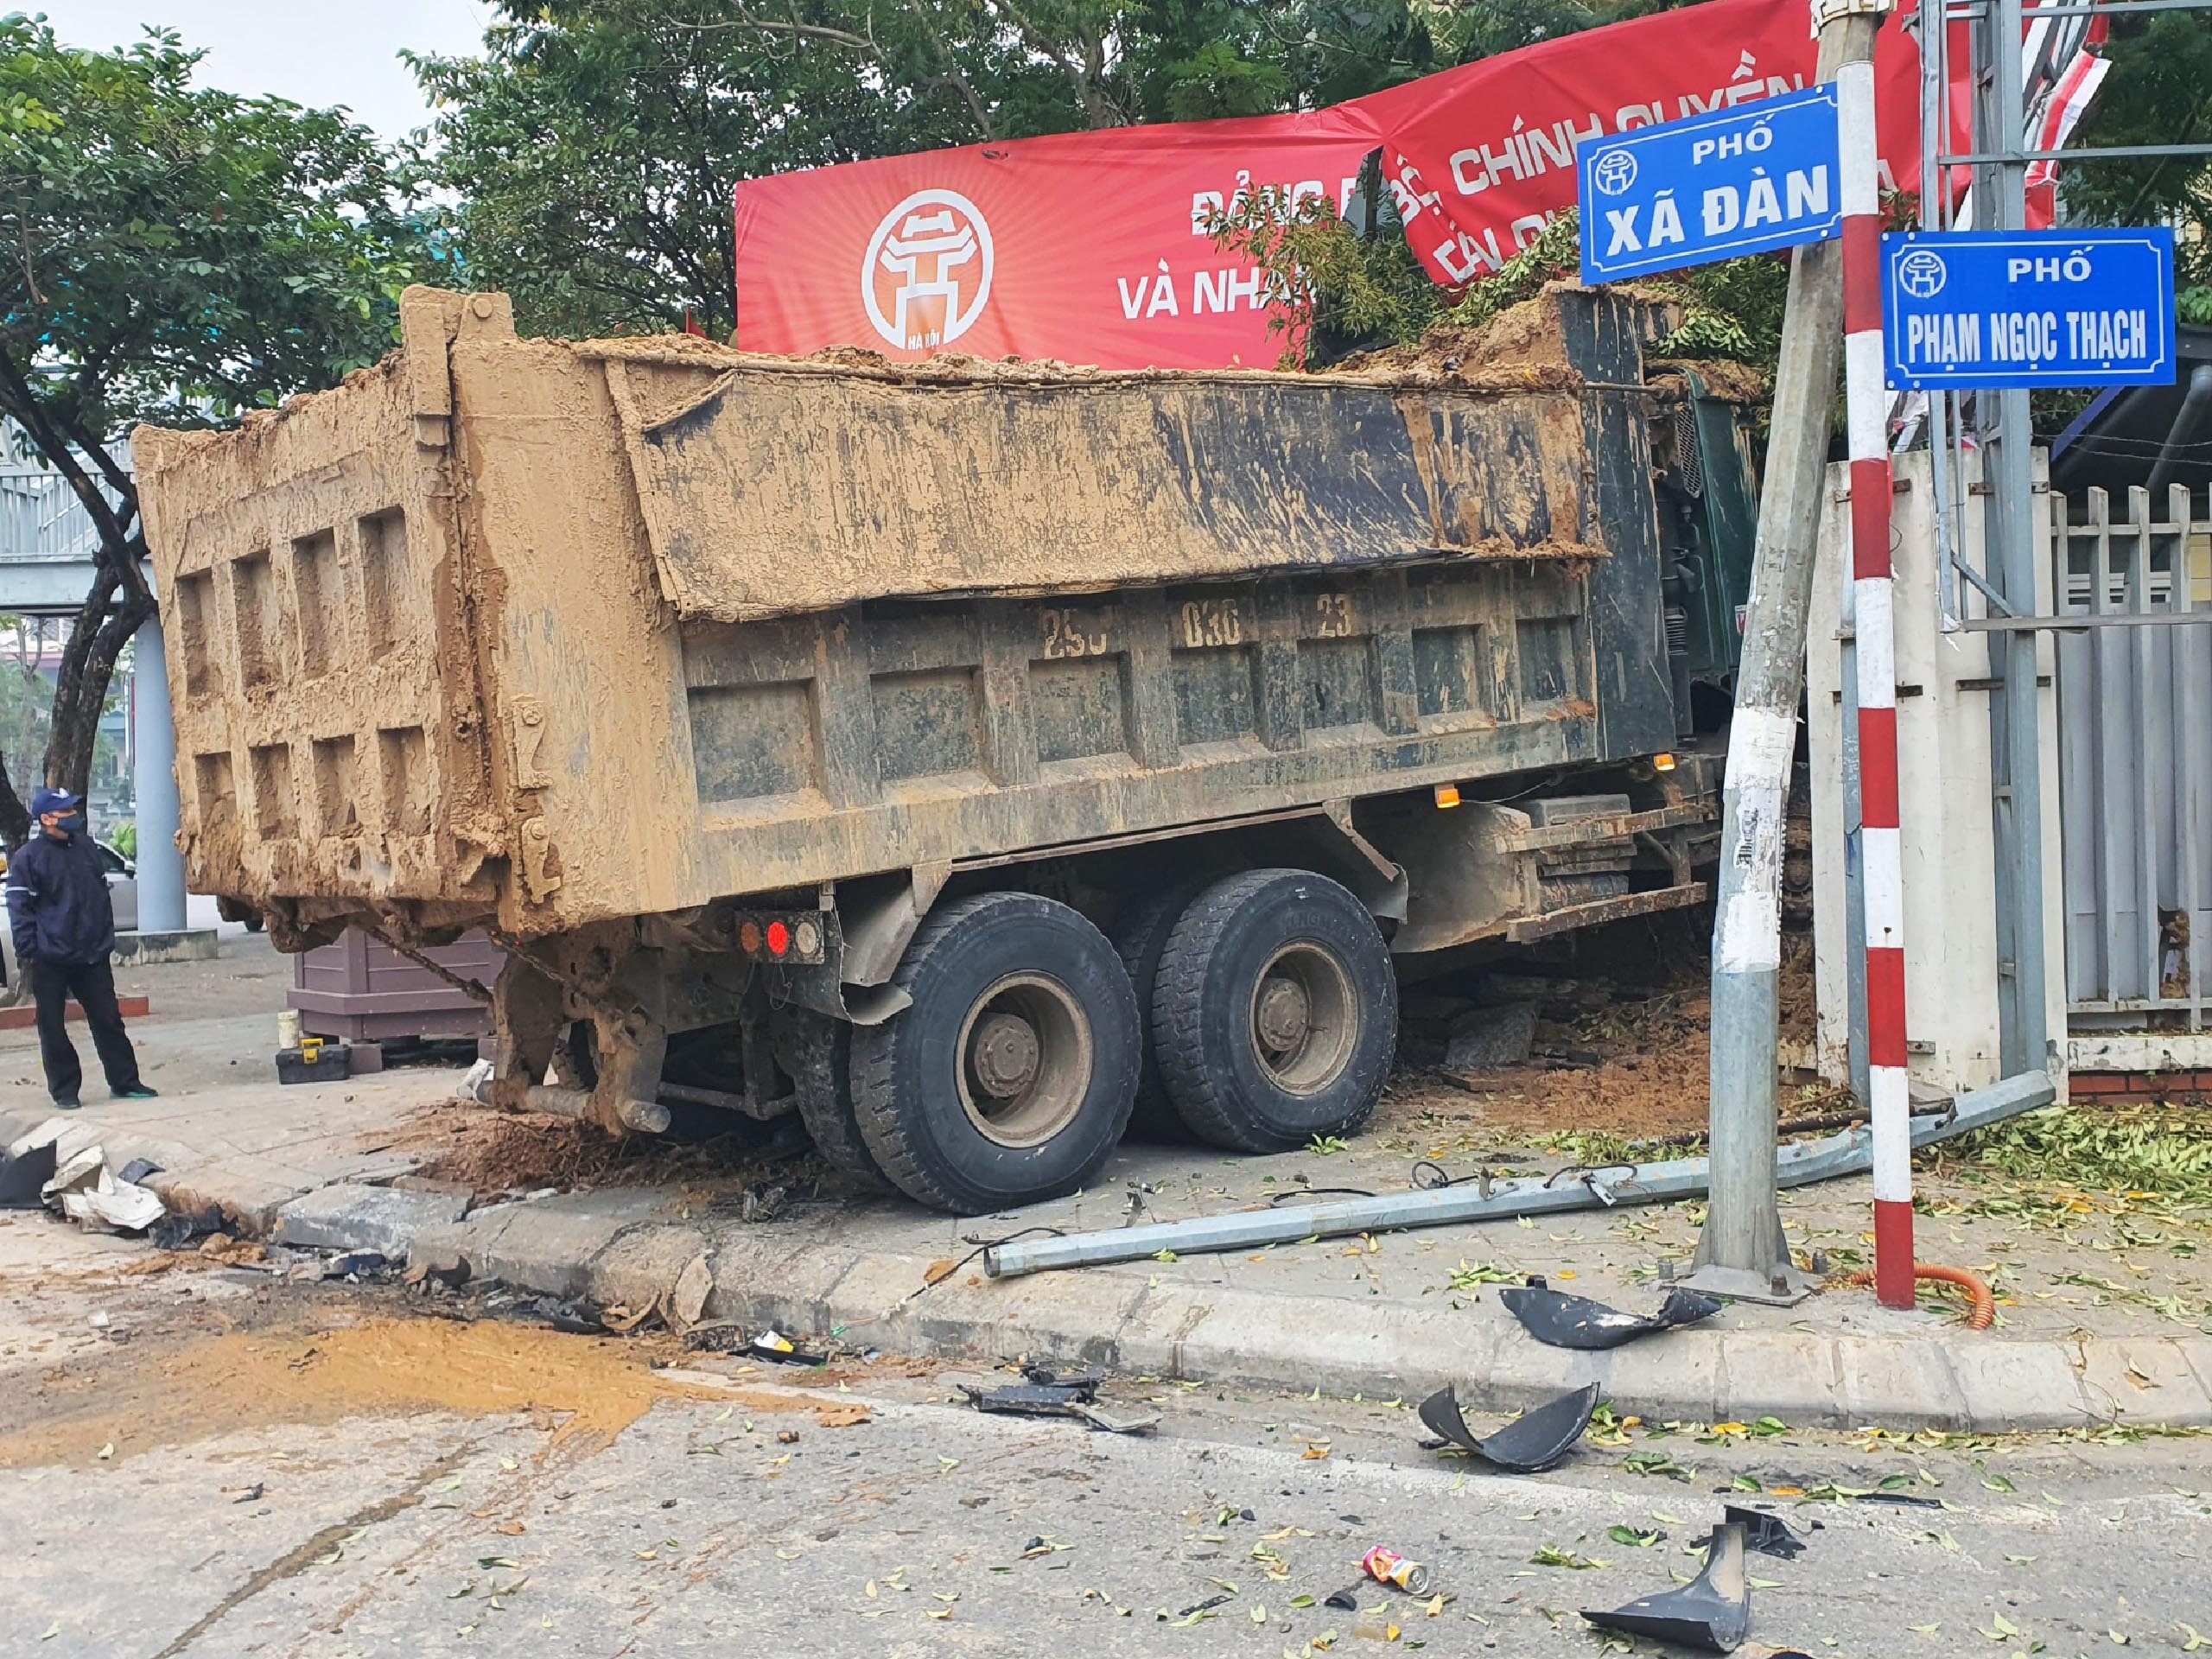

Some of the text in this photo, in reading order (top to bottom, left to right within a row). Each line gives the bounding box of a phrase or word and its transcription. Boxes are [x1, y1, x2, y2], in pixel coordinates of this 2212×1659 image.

[1450, 114, 1604, 195] CHÍNH
[1693, 112, 1776, 165] PHỐ
[1605, 188, 1685, 257] XÃ
[1702, 164, 1829, 237] ĐÀN
[1117, 257, 1179, 320] VÀ
[2007, 245, 2094, 283] PHỐ
[1907, 308, 2146, 372] PHẠM NGỌC THẠCH
